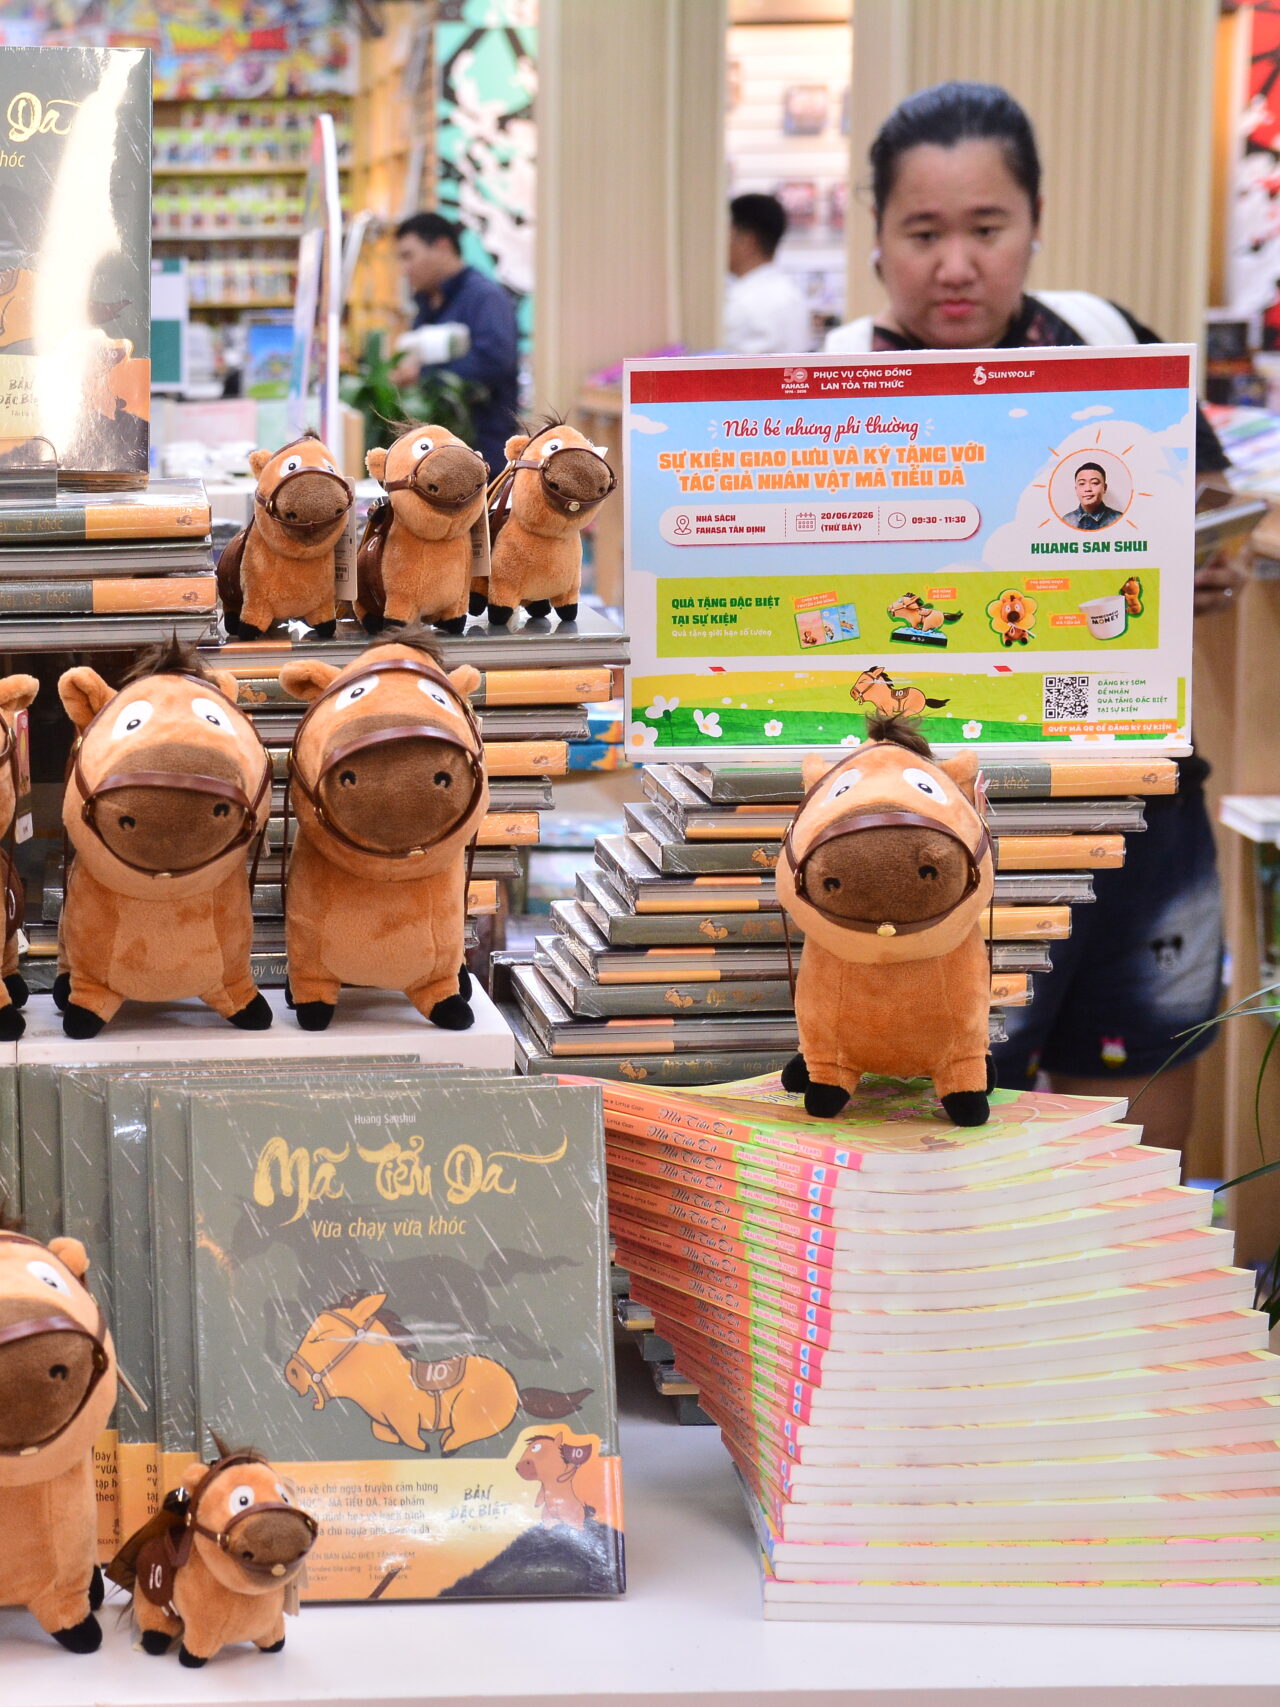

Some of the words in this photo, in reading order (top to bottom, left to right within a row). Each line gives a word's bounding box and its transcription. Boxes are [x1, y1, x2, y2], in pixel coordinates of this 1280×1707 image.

[784, 368, 808, 383] 50
[813, 371, 839, 380] PHỤC
[841, 370, 854, 379] VỤ
[856, 368, 883, 379] CỘNG
[884, 367, 913, 377] ĐỒNG
[988, 370, 1036, 379] SUNWOLF
[821, 382, 839, 390] LAN
[841, 380, 861, 390] TỎA
[862, 381, 877, 389] TRI
[879, 379, 905, 389] THỨC
[722, 418, 758, 438] Nhỏ
[763, 416, 782, 437] bé
[785, 416, 831, 443] nhưng
[834, 415, 862, 444] phi
[865, 414, 920, 442] thường
[659, 451, 686, 473] SỰ
[690, 448, 736, 472] KIỆN
[740, 450, 786, 468] GIAO
[791, 446, 828, 467] LƯU
[833, 444, 858, 466] VÀ
[864, 443, 889, 465] KÝ
[895, 443, 946, 467] TẶNG
[950, 441, 986, 463] VỚI
[678, 471, 715, 492] TÁC
[719, 469, 755, 491] GIẢ
[757, 470, 810, 490] NHÂN
[813, 469, 851, 493] VẬT
[855, 468, 886, 488] MÃ
[891, 464, 935, 487] TIỂU
[939, 464, 965, 486] DÃ
[696, 514, 712, 522] NHÀ
[714, 513, 736, 522] SÁCH
[820, 511, 874, 520] 20/06/2026
[911, 515, 937, 525] 09:30
[944, 514, 967, 524] 11:30
[729, 525, 745, 534] TÂN
[746, 526, 767, 536] ĐỊNH
[821, 523, 839, 532] (THỨ
[841, 522, 862, 532] BẢY)
[1031, 541, 1079, 555] HUANG
[1082, 541, 1111, 553] SAN
[1114, 540, 1148, 553] SHUI
[672, 596, 694, 609] QUÀ
[699, 595, 727, 611] TẶNG
[729, 595, 754, 611] ĐẶC
[756, 594, 780, 609] BIỆT
[672, 615, 690, 627] TẠI
[692, 613, 709, 627] SỰ
[710, 612, 738, 626] KIỆN
[354, 1112, 382, 1126] Huang
[384, 1111, 417, 1125] Sanshui
[254, 1136, 350, 1227] Mã
[356, 1135, 433, 1201] Tiểu
[444, 1134, 569, 1205] Dã
[312, 1219, 342, 1238] Vừa
[348, 1216, 387, 1242] chạy
[393, 1216, 423, 1237] vừa
[429, 1213, 467, 1236] khóc
[425, 1362, 450, 1382] 10
[572, 1448, 584, 1458] 10
[364, 1482, 393, 1494] truyền
[396, 1481, 413, 1492] cảm
[416, 1481, 439, 1494] hứng
[464, 1484, 494, 1501] BẢN
[149, 1564, 163, 1590] 10
